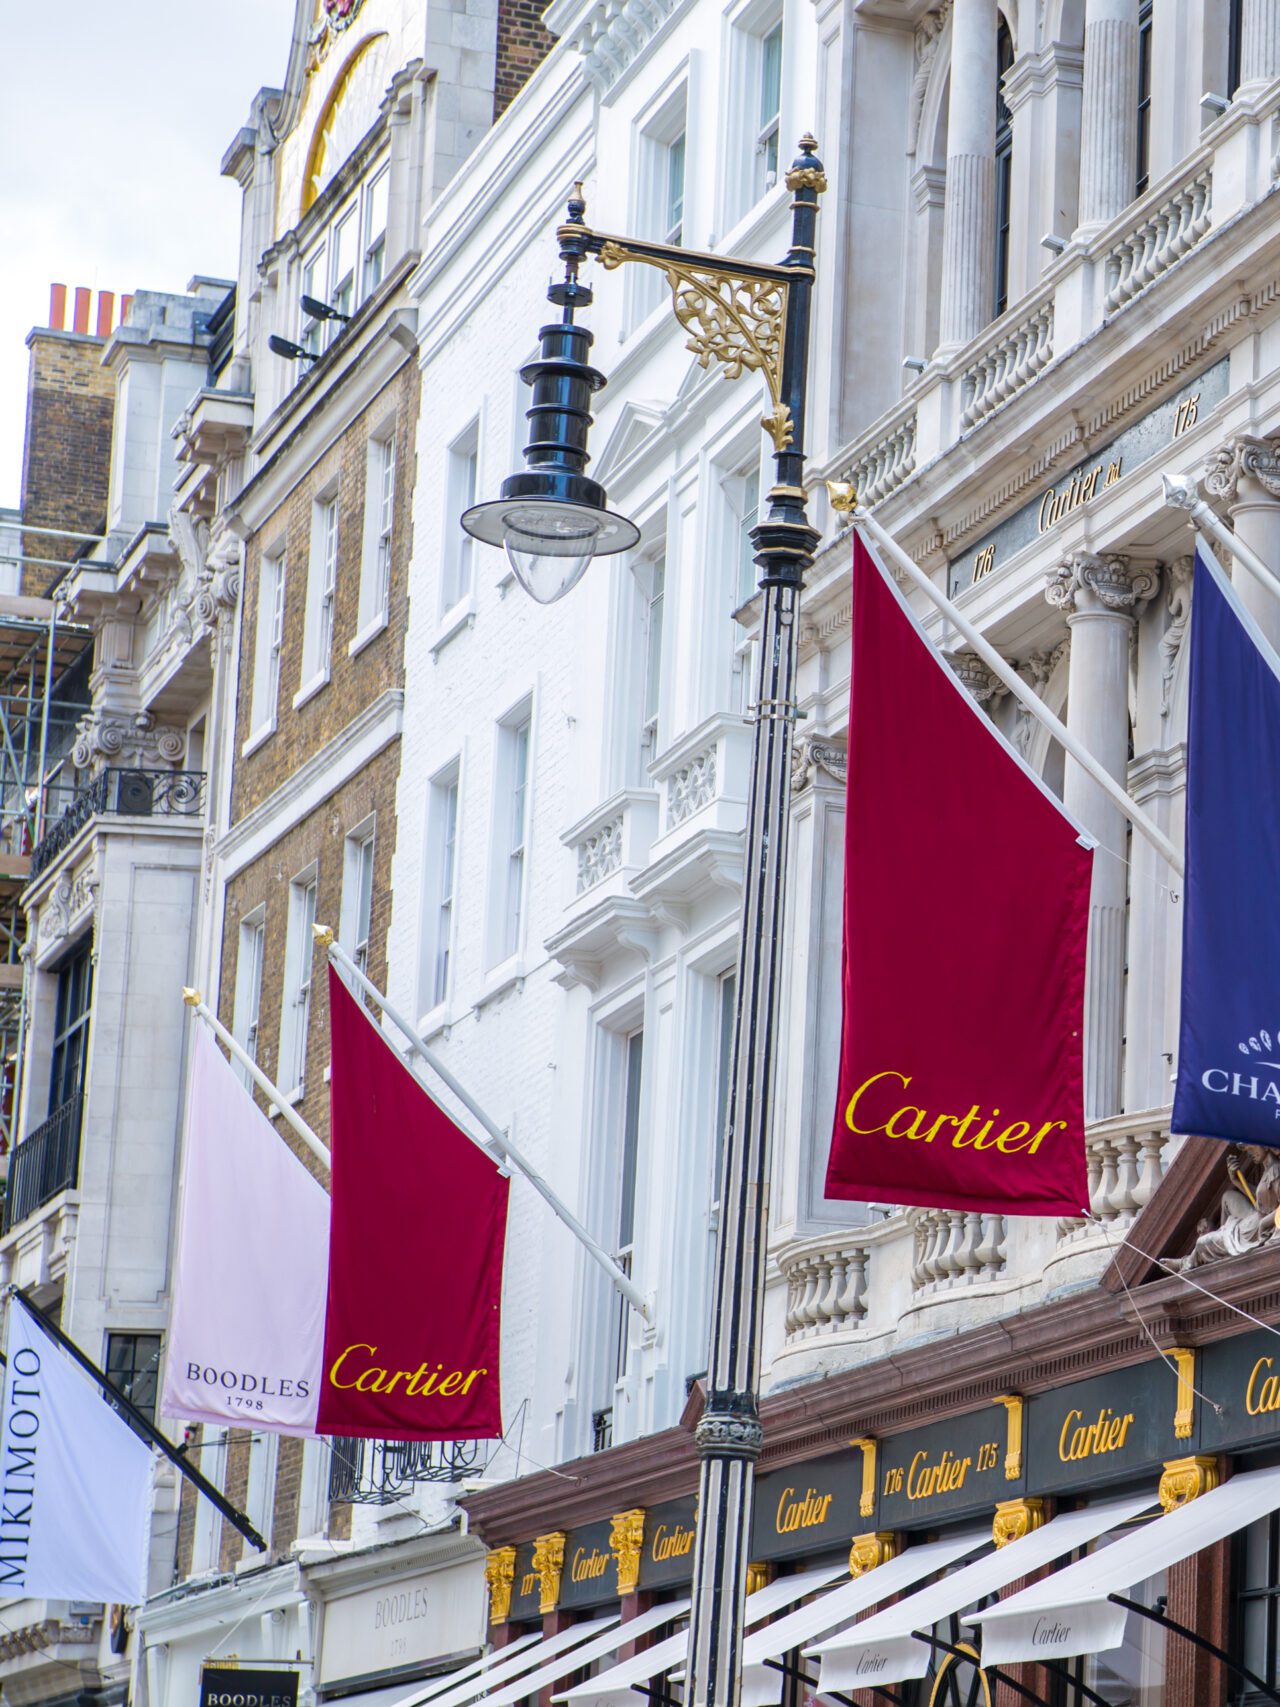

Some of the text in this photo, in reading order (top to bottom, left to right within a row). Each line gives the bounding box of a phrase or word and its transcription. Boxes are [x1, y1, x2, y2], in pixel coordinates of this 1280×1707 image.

[972, 544, 996, 585] 176
[1039, 467, 1102, 534] Cartier
[1172, 393, 1200, 439] 175
[844, 1070, 1068, 1155] Cartier
[186, 1362, 310, 1398] BOODLES
[329, 1343, 488, 1396] Cartier
[227, 1396, 264, 1410] 1798
[1058, 1408, 1135, 1462] Cartier
[0, 1347, 41, 1588] MIKIMOTO
[883, 1443, 999, 1501] 176 Cartier 175
[775, 1487, 833, 1534] Cartier
[571, 1546, 611, 1583] Cartier
[652, 1524, 695, 1562] Cartier
[374, 1587, 429, 1630] BOODLES
[1032, 1615, 1071, 1647] Cartier
[855, 1649, 889, 1676] Cartier
[207, 1693, 292, 1707] BOODLES
